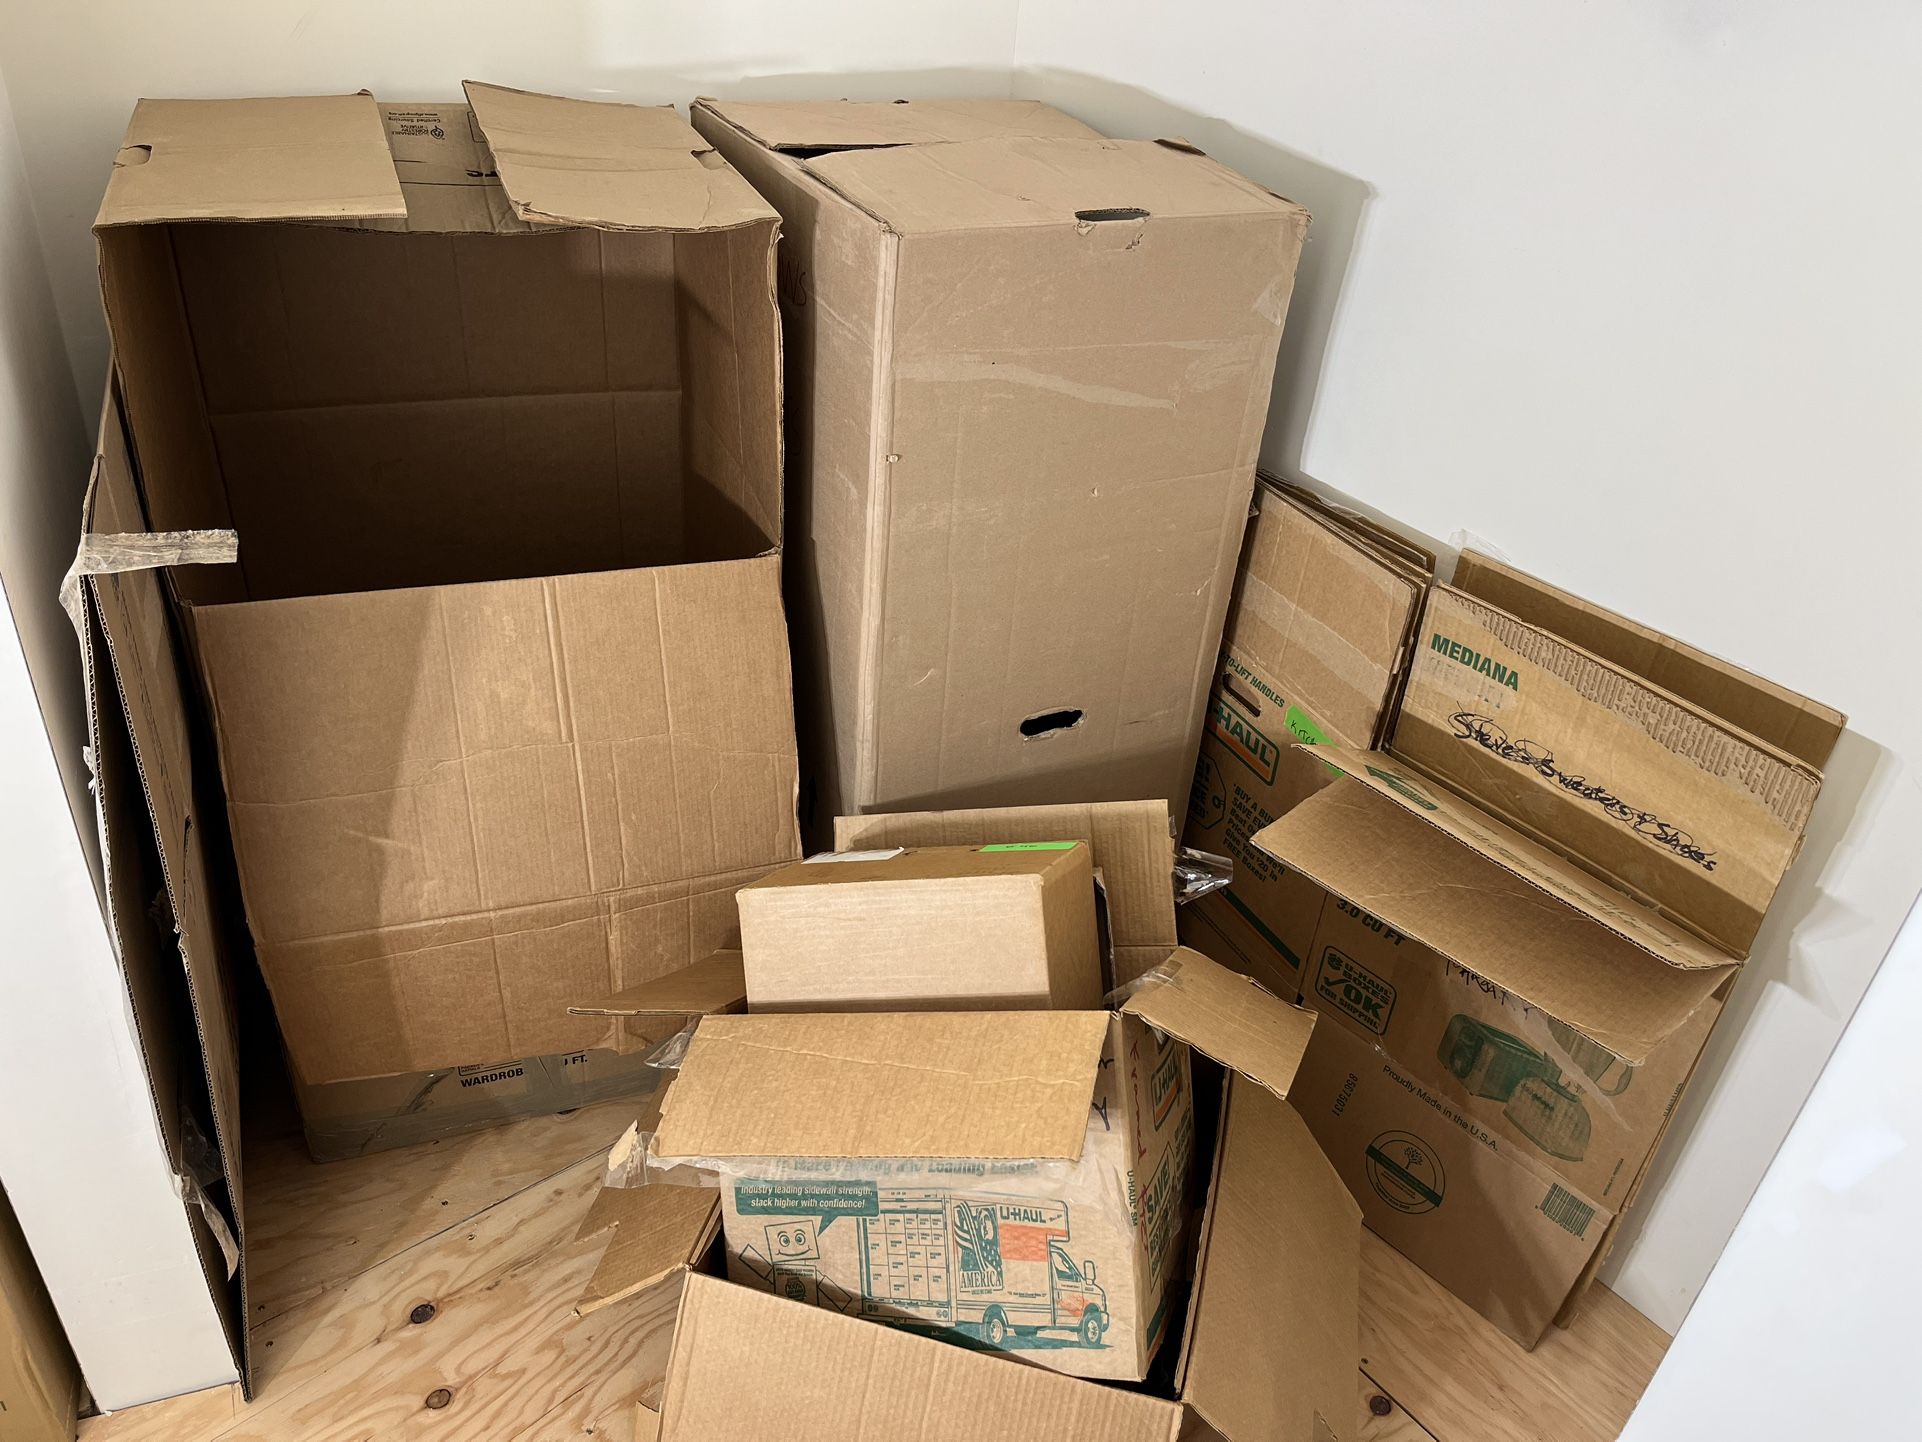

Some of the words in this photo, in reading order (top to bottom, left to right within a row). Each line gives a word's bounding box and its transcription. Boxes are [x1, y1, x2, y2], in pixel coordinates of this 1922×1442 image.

[1430, 632, 1520, 693] MEDIANA
[1249, 674, 1286, 709] HANDLES
[1231, 797, 1253, 818] SAVE
[1222, 837, 1243, 859] FREE
[1337, 898, 1360, 919] 3.0
[1361, 911, 1382, 933] CU
[1384, 927, 1407, 947] FT
[1319, 984, 1338, 1003] FOR
[1343, 969, 1390, 1006] BOXES
[1343, 983, 1388, 1021] OK
[460, 1067, 524, 1088] WARDROB
[1382, 1064, 1417, 1094] Proudly
[1415, 1087, 1442, 1112] Made
[1442, 1106, 1453, 1119] in
[1452, 1112, 1469, 1131] the
[1468, 1125, 1499, 1152] U.S.A.
[741, 1185, 773, 1196] Industry
[774, 1185, 803, 1196] leading
[804, 1185, 837, 1195] sidewall
[837, 1186, 873, 1197] strength,
[750, 1197, 773, 1207] stack
[774, 1197, 799, 1208] higher
[801, 1197, 818, 1207] with
[819, 1197, 866, 1209] confidence!
[999, 1205, 1047, 1224] U-HAUL
[1130, 1210, 1138, 1227] SM
[960, 1269, 1002, 1290] AMERICA
